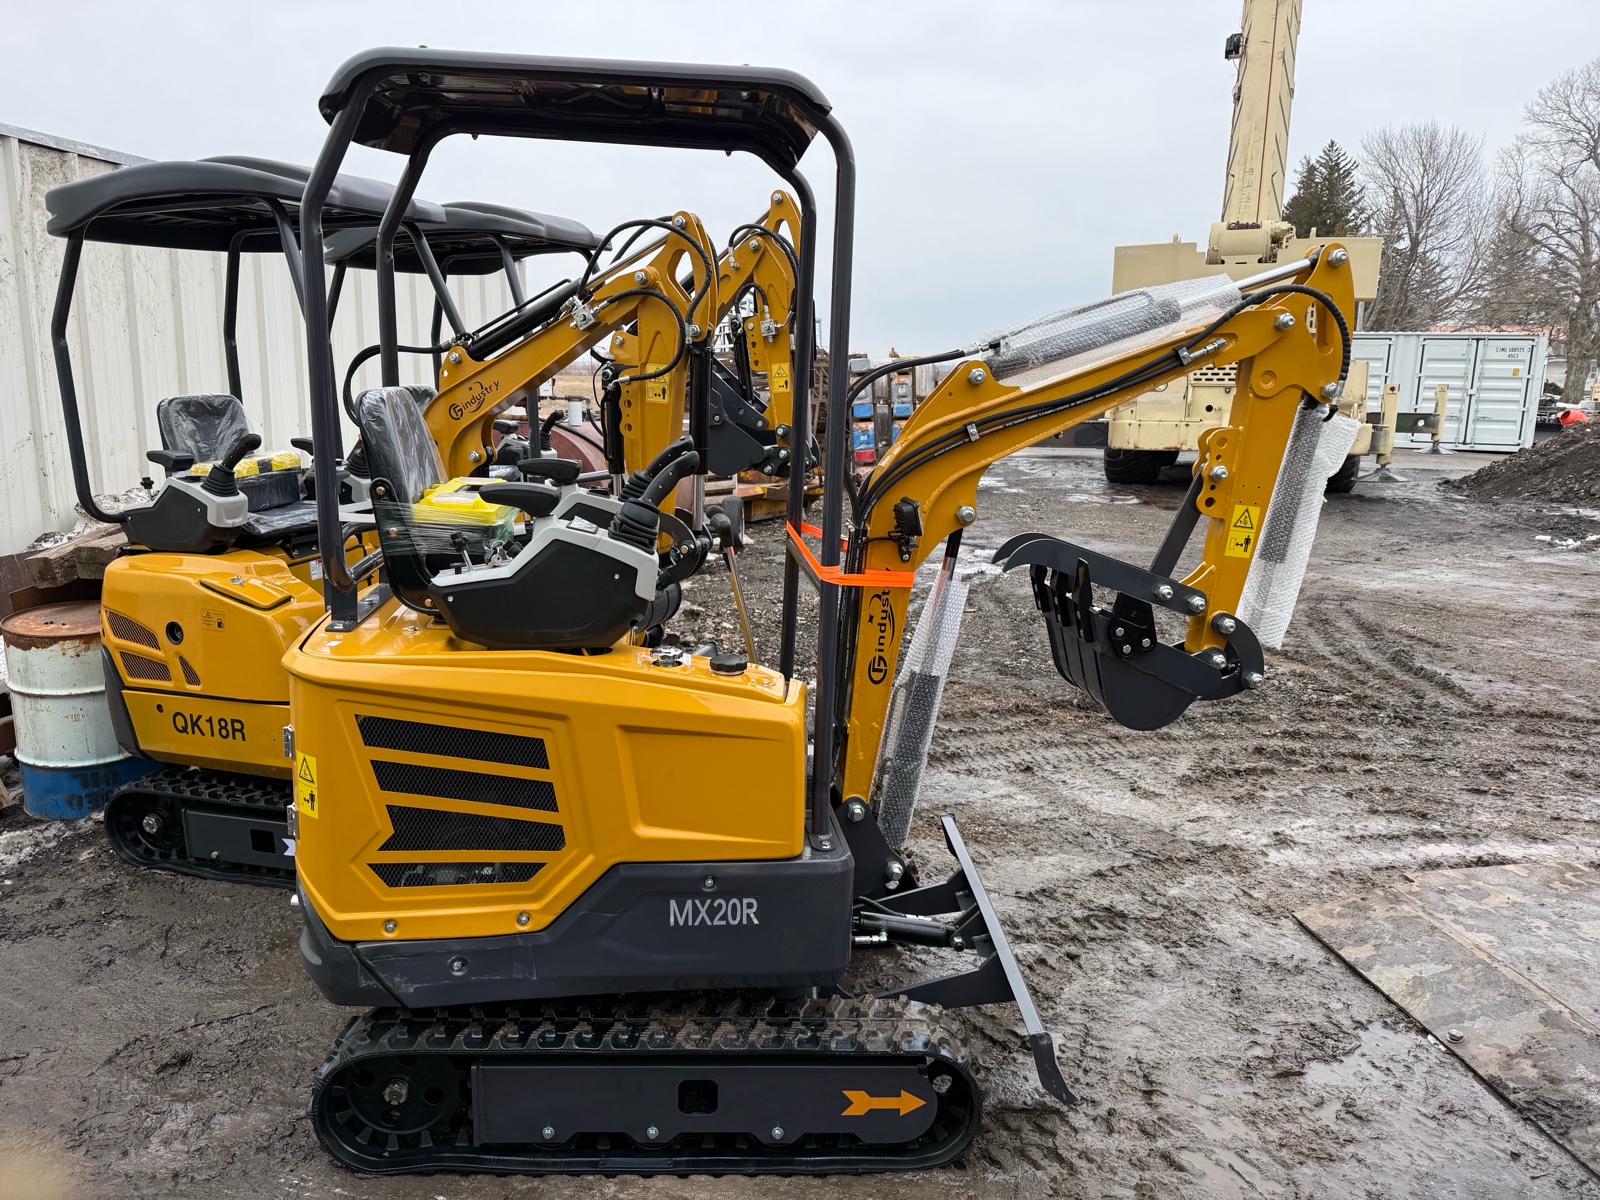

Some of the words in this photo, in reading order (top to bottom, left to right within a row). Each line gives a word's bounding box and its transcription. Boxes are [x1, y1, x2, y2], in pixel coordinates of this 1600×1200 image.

[868, 567, 891, 685] Gindust
[172, 711, 247, 742] QK18R
[669, 897, 760, 927] MX20R
